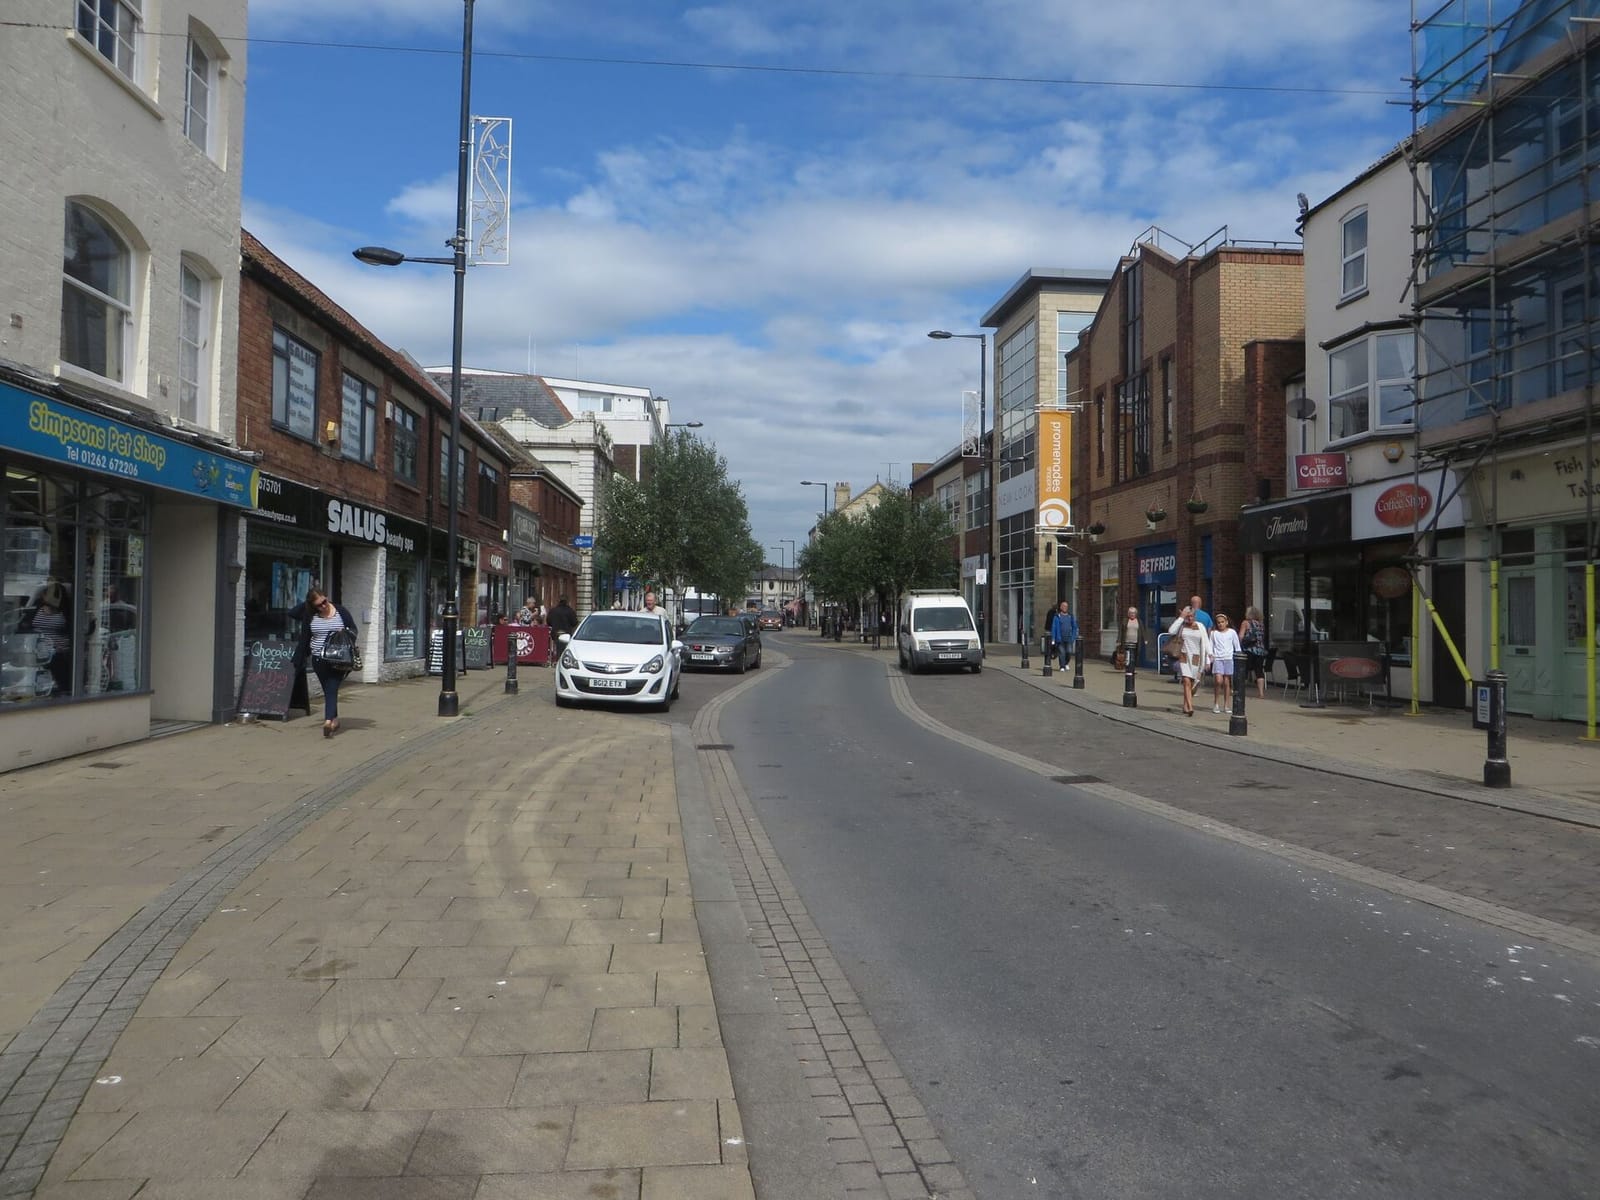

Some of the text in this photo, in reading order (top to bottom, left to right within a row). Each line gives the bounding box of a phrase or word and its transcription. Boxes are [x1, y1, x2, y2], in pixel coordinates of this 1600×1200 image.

[29, 401, 166, 471] Simpsons Pet Shop
[66, 445, 138, 477] Tel 01262 672206
[1050, 421, 1063, 493] promenades
[1554, 457, 1583, 475] Fish
[1300, 464, 1342, 477] Coffee
[1312, 477, 1329, 485] Shop
[1377, 497, 1407, 513] Coffee
[328, 500, 414, 553] SALUS beauty spa
[1140, 555, 1176, 574] BETFRED
